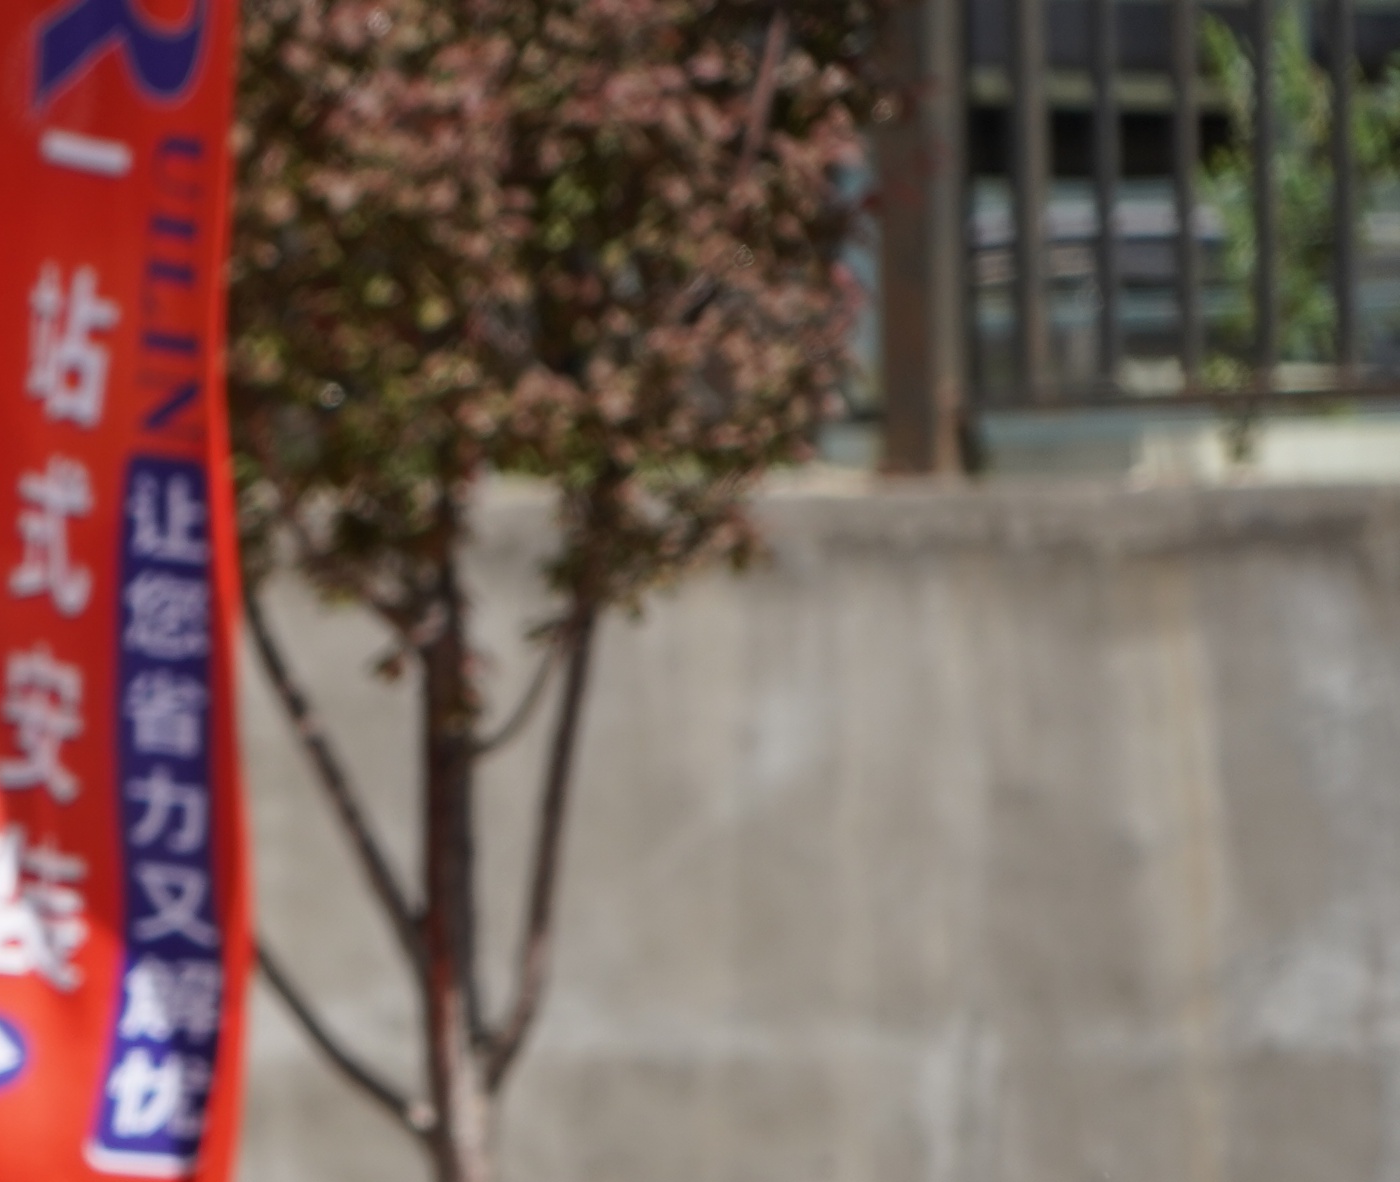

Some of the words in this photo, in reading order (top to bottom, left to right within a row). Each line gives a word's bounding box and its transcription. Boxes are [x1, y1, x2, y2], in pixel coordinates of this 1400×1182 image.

[136, 132, 207, 458] UILIN
[105, 470, 224, 1142] 让您省力又解忧
